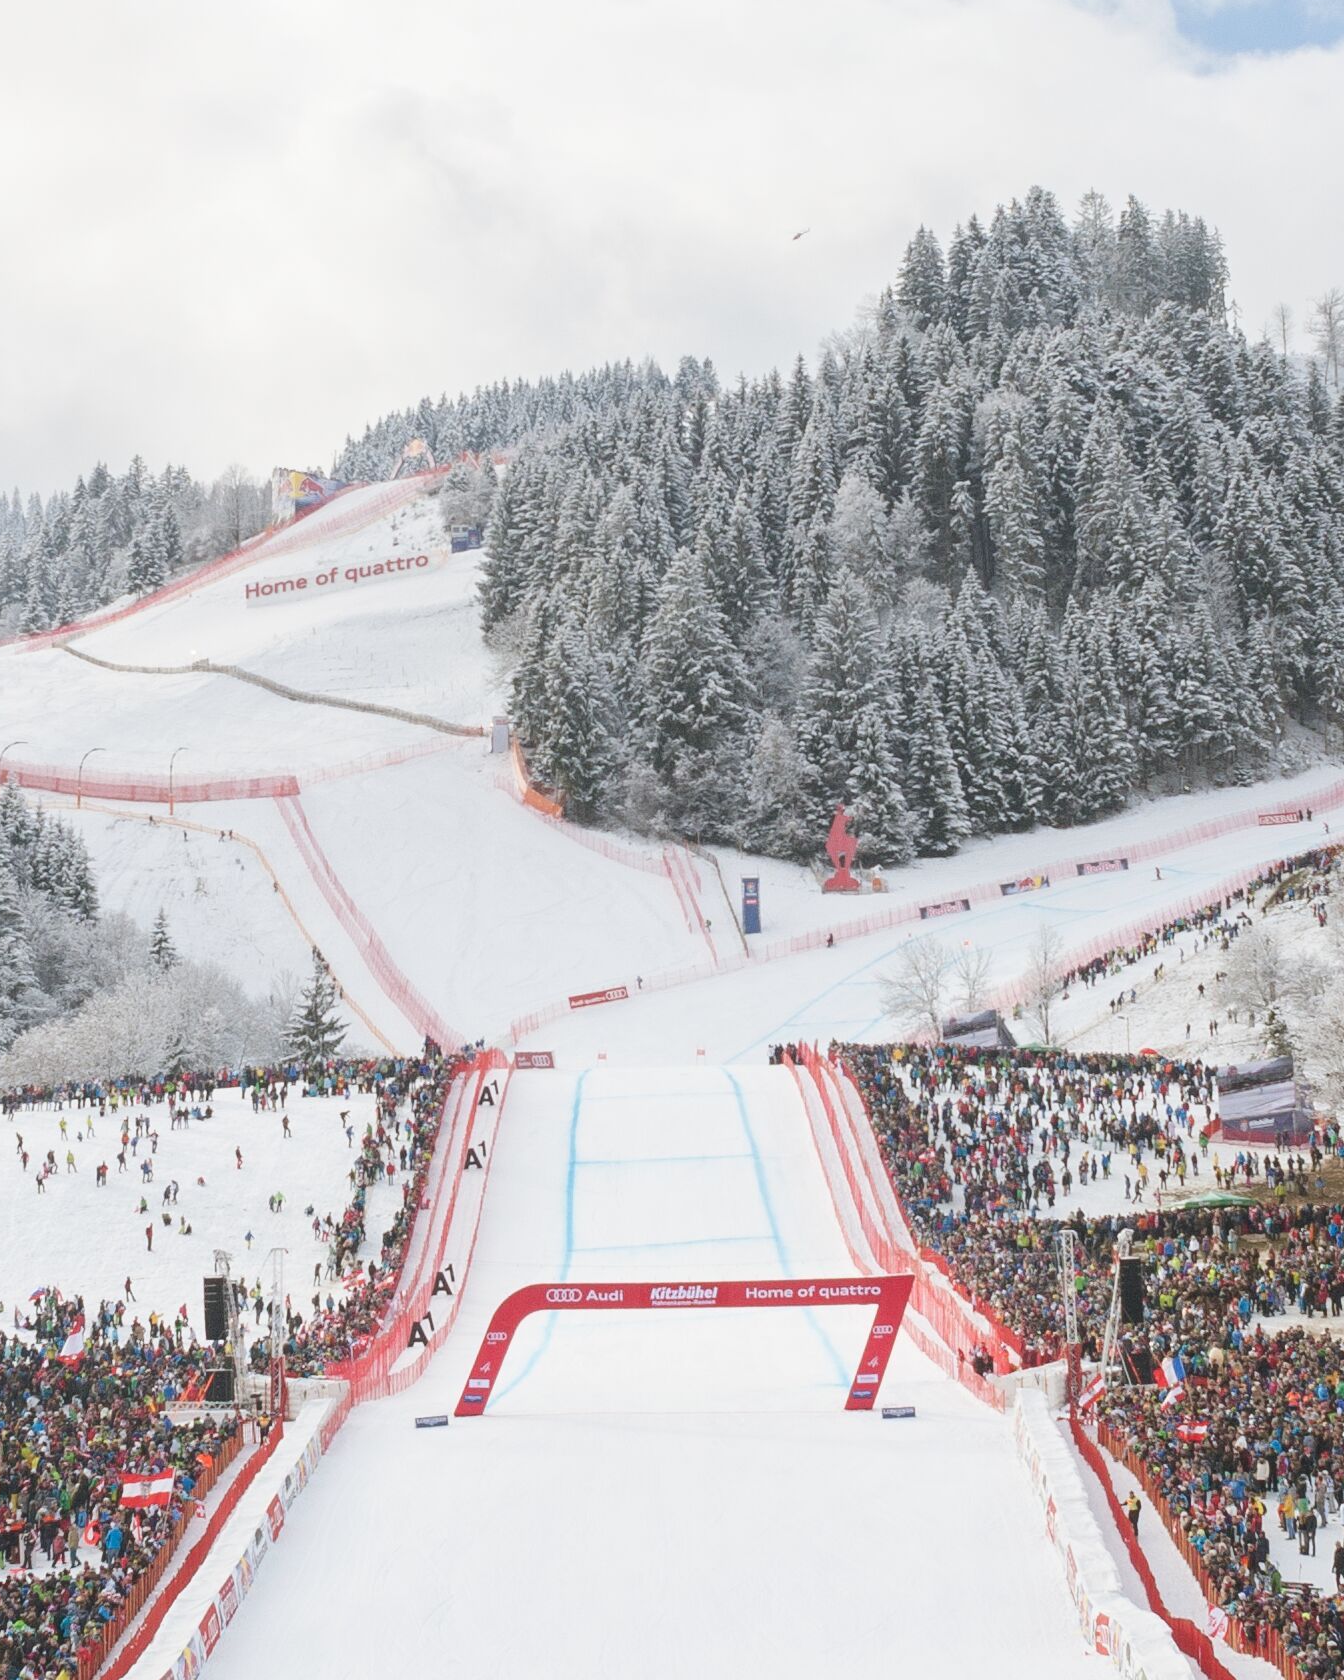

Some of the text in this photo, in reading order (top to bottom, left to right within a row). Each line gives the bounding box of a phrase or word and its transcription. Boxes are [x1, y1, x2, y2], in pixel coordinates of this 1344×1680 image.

[245, 554, 428, 599] Home of quattro
[586, 1285, 881, 1302] Audi Kitzbühel Home of quattro
